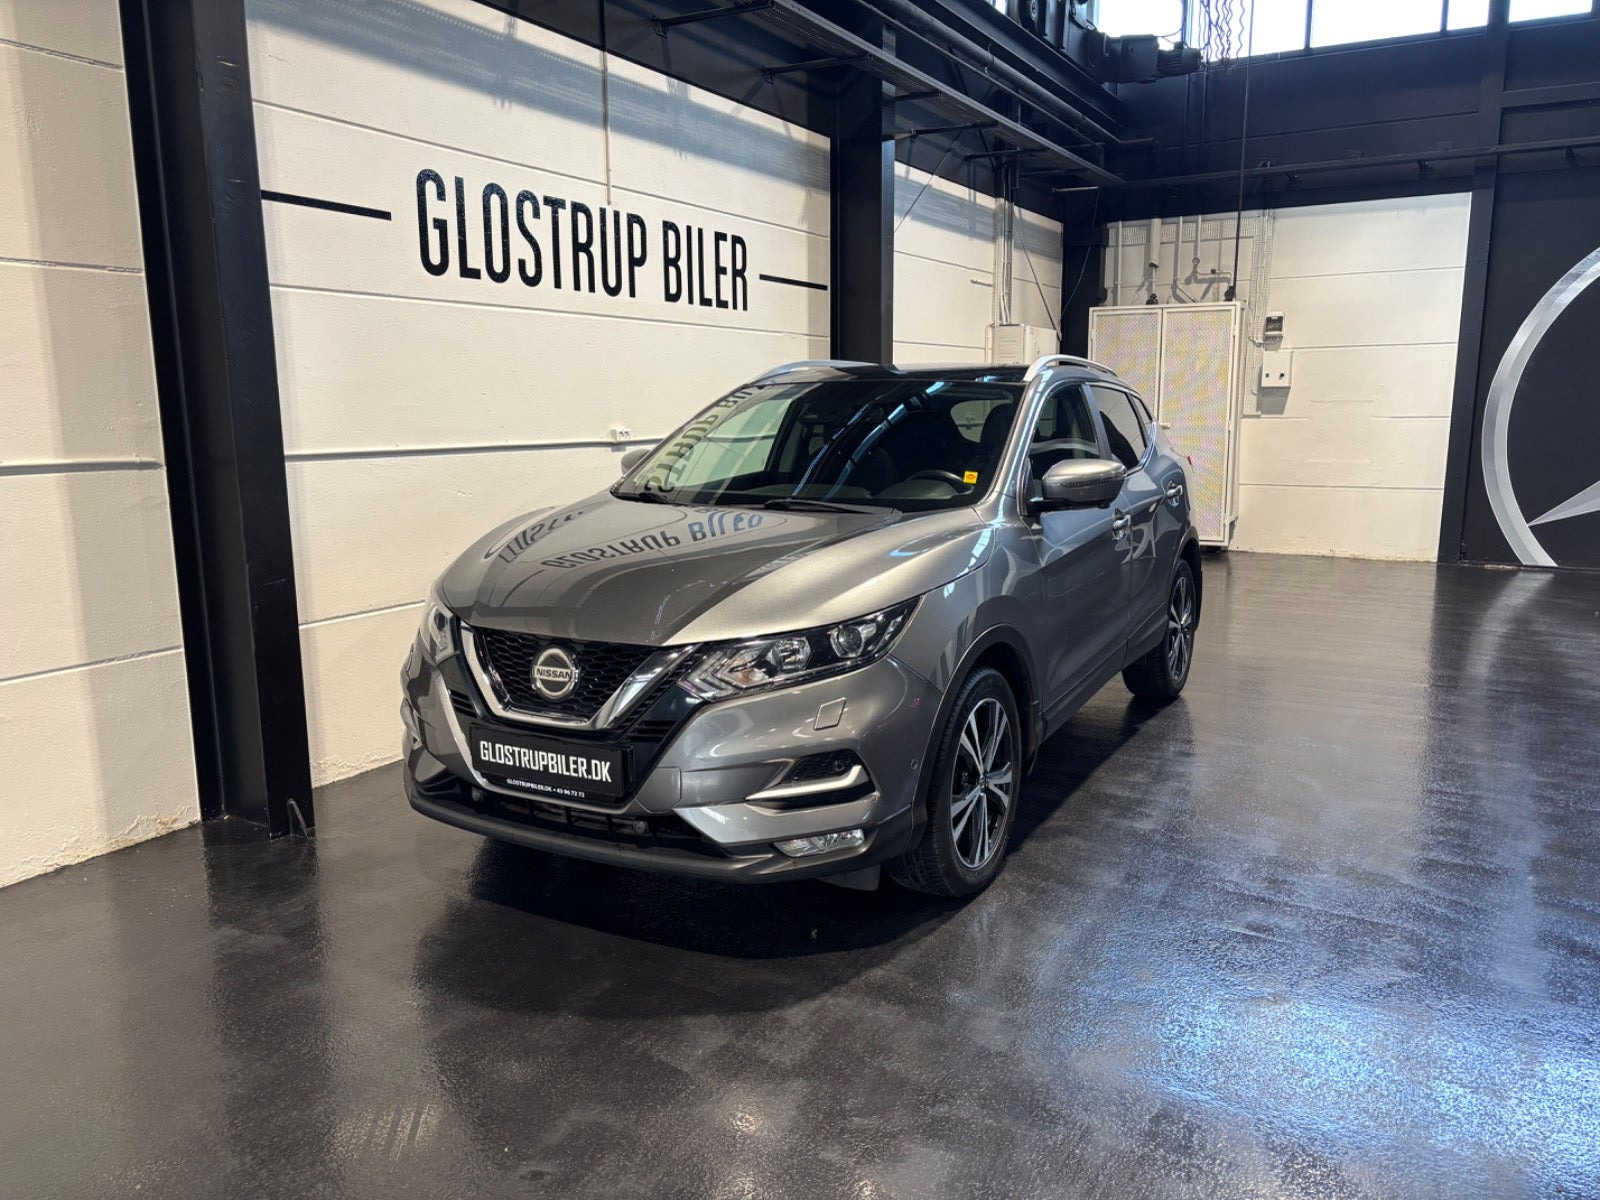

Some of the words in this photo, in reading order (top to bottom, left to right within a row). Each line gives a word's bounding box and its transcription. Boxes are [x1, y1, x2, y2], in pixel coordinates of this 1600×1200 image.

[416, 168, 647, 298] GLOSTRUP
[662, 220, 748, 311] BILER
[536, 667, 571, 680] NISSAN
[480, 740, 612, 783] GLOSTRUPBILER.DK
